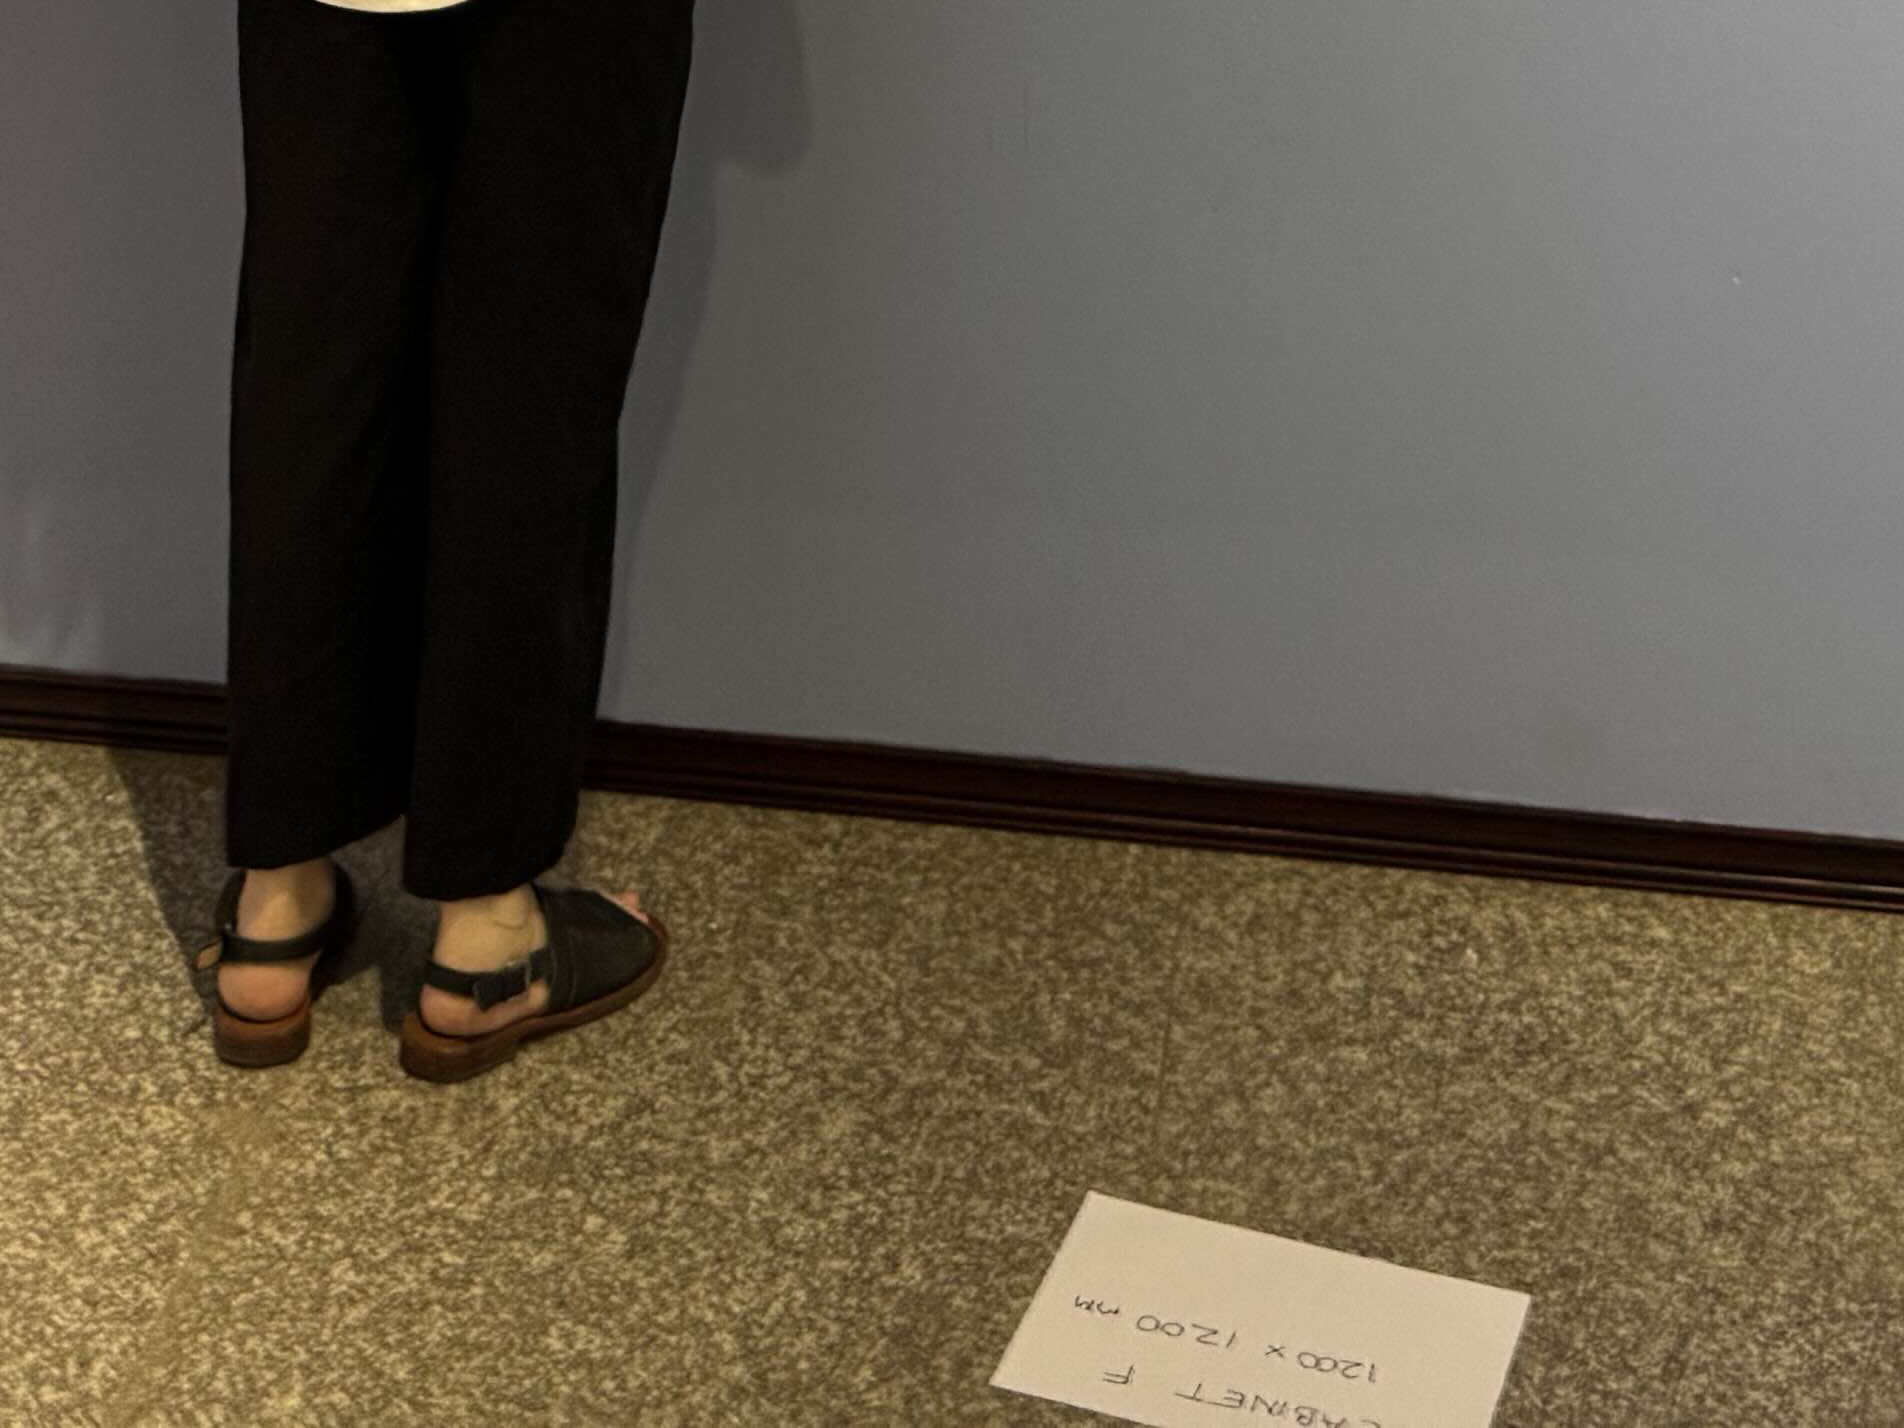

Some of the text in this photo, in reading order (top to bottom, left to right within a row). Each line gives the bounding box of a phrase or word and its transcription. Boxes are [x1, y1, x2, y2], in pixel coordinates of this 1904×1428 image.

[1136, 1315, 1236, 1348] 1200
[1103, 1365, 1135, 1385] F
[1297, 1352, 1376, 1383] 1200
